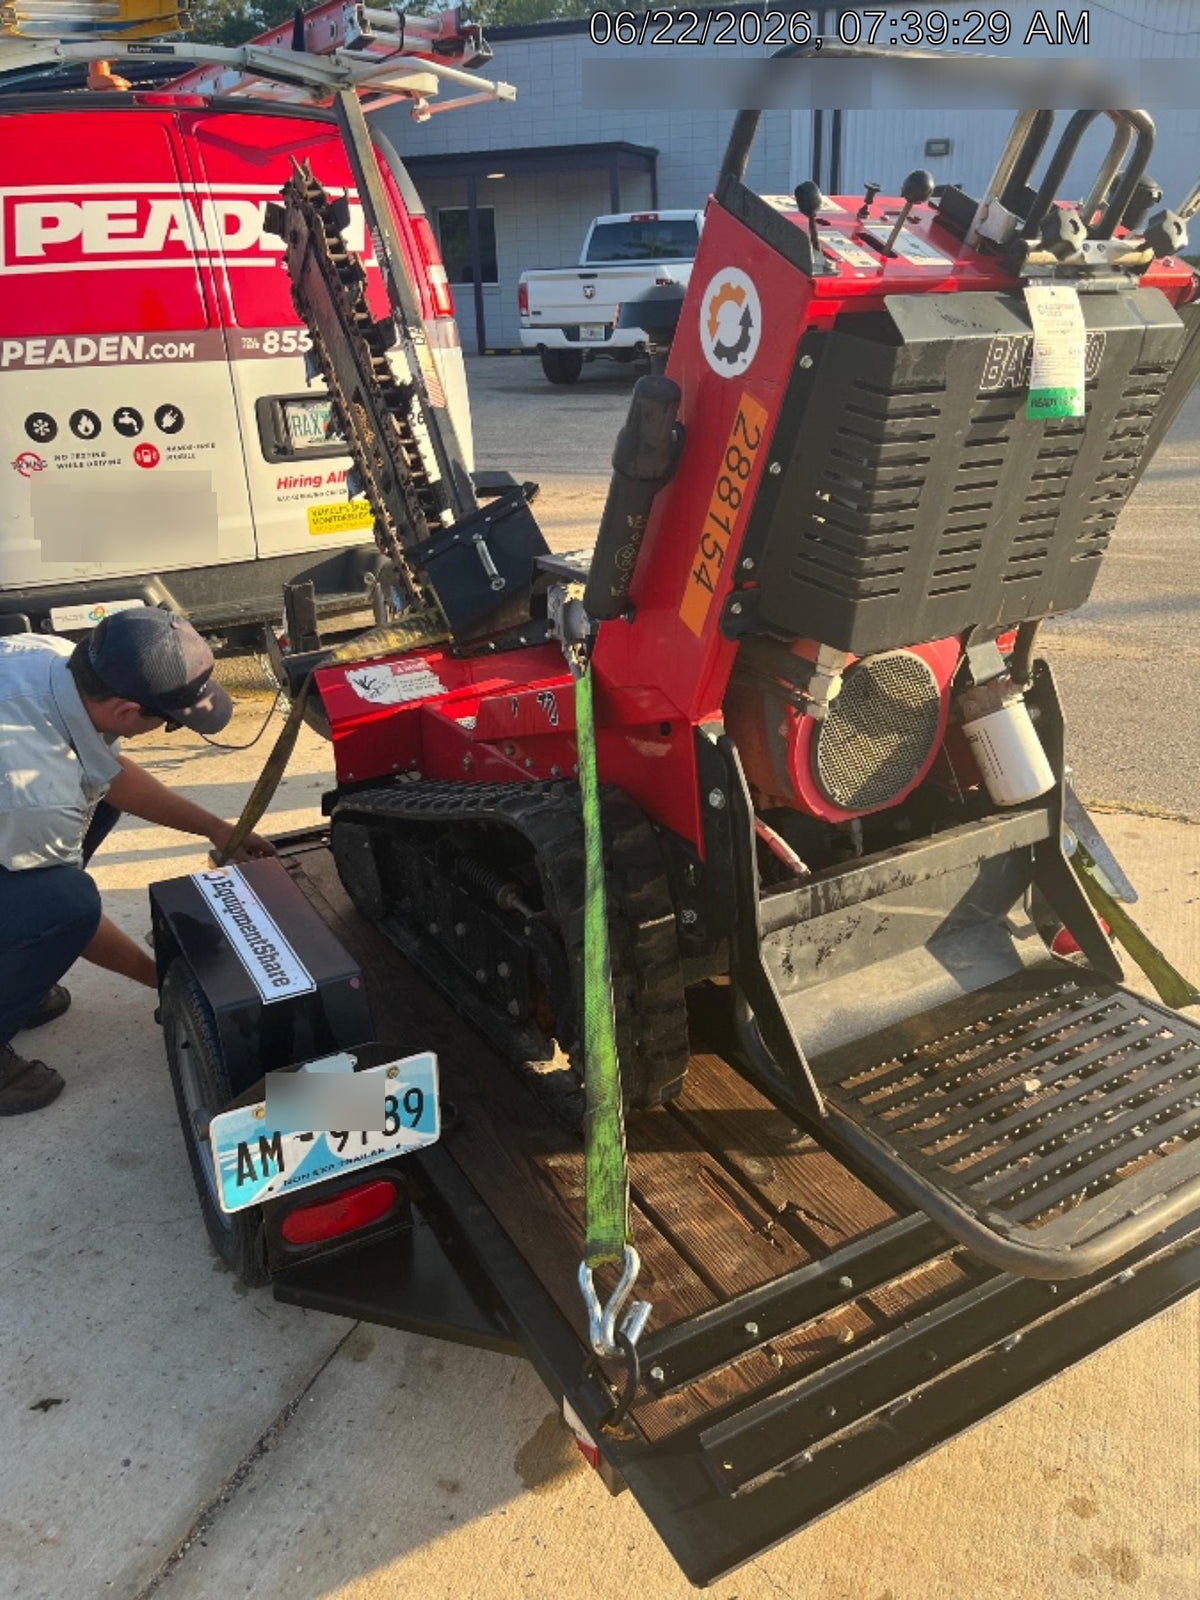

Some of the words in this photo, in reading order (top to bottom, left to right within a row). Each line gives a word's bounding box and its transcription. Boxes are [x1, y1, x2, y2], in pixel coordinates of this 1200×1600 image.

[1, 335, 195, 368] PEADEN.COM
[276, 474, 322, 490] Hiring
[692, 409, 761, 595] 288154
